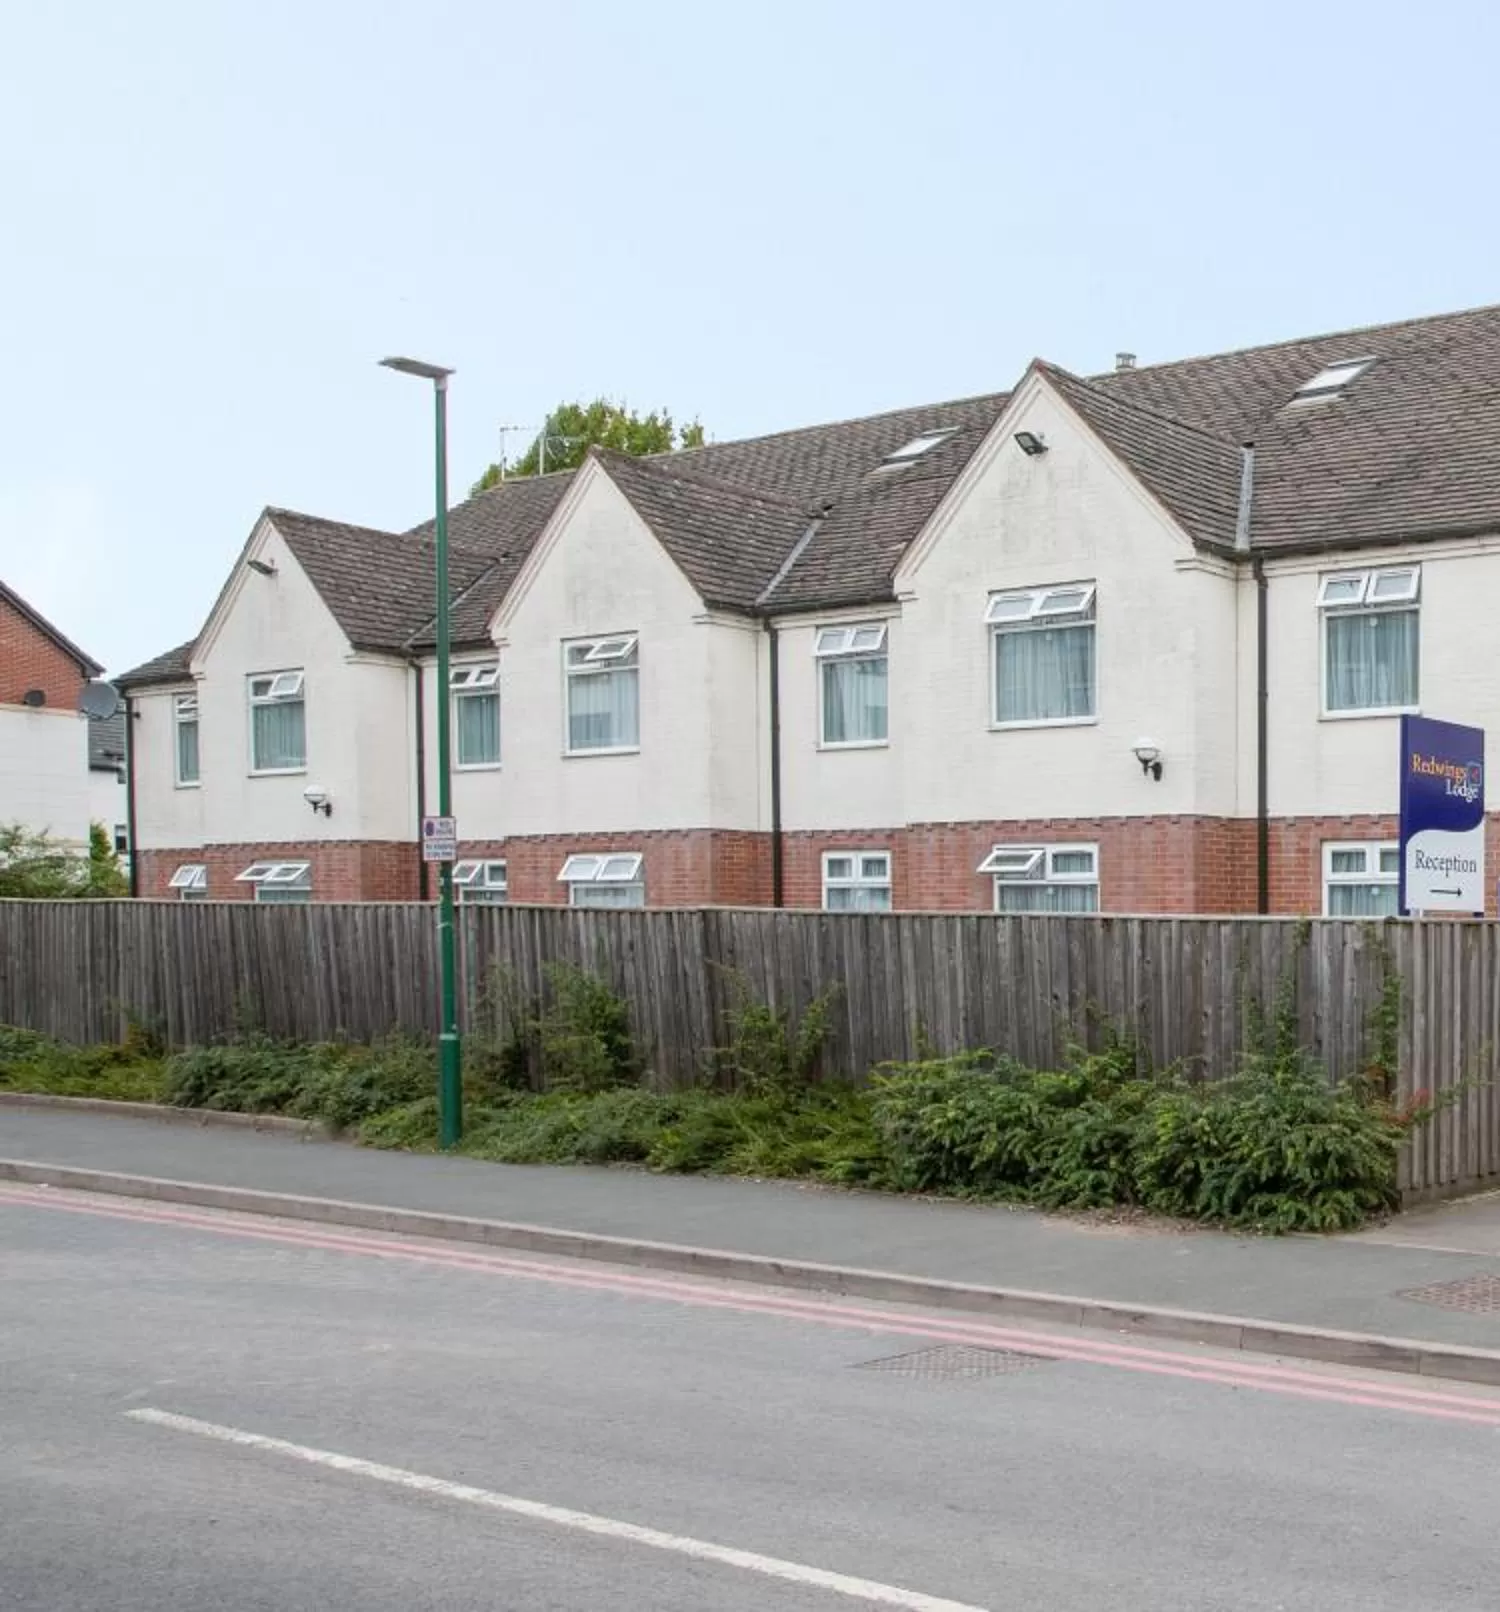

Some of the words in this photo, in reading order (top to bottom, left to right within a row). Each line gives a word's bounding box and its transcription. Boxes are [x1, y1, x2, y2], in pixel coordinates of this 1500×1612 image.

[1412, 753, 1468, 785] Redwings
[1445, 778, 1479, 803] Lodge
[1415, 849, 1477, 878] Reception
